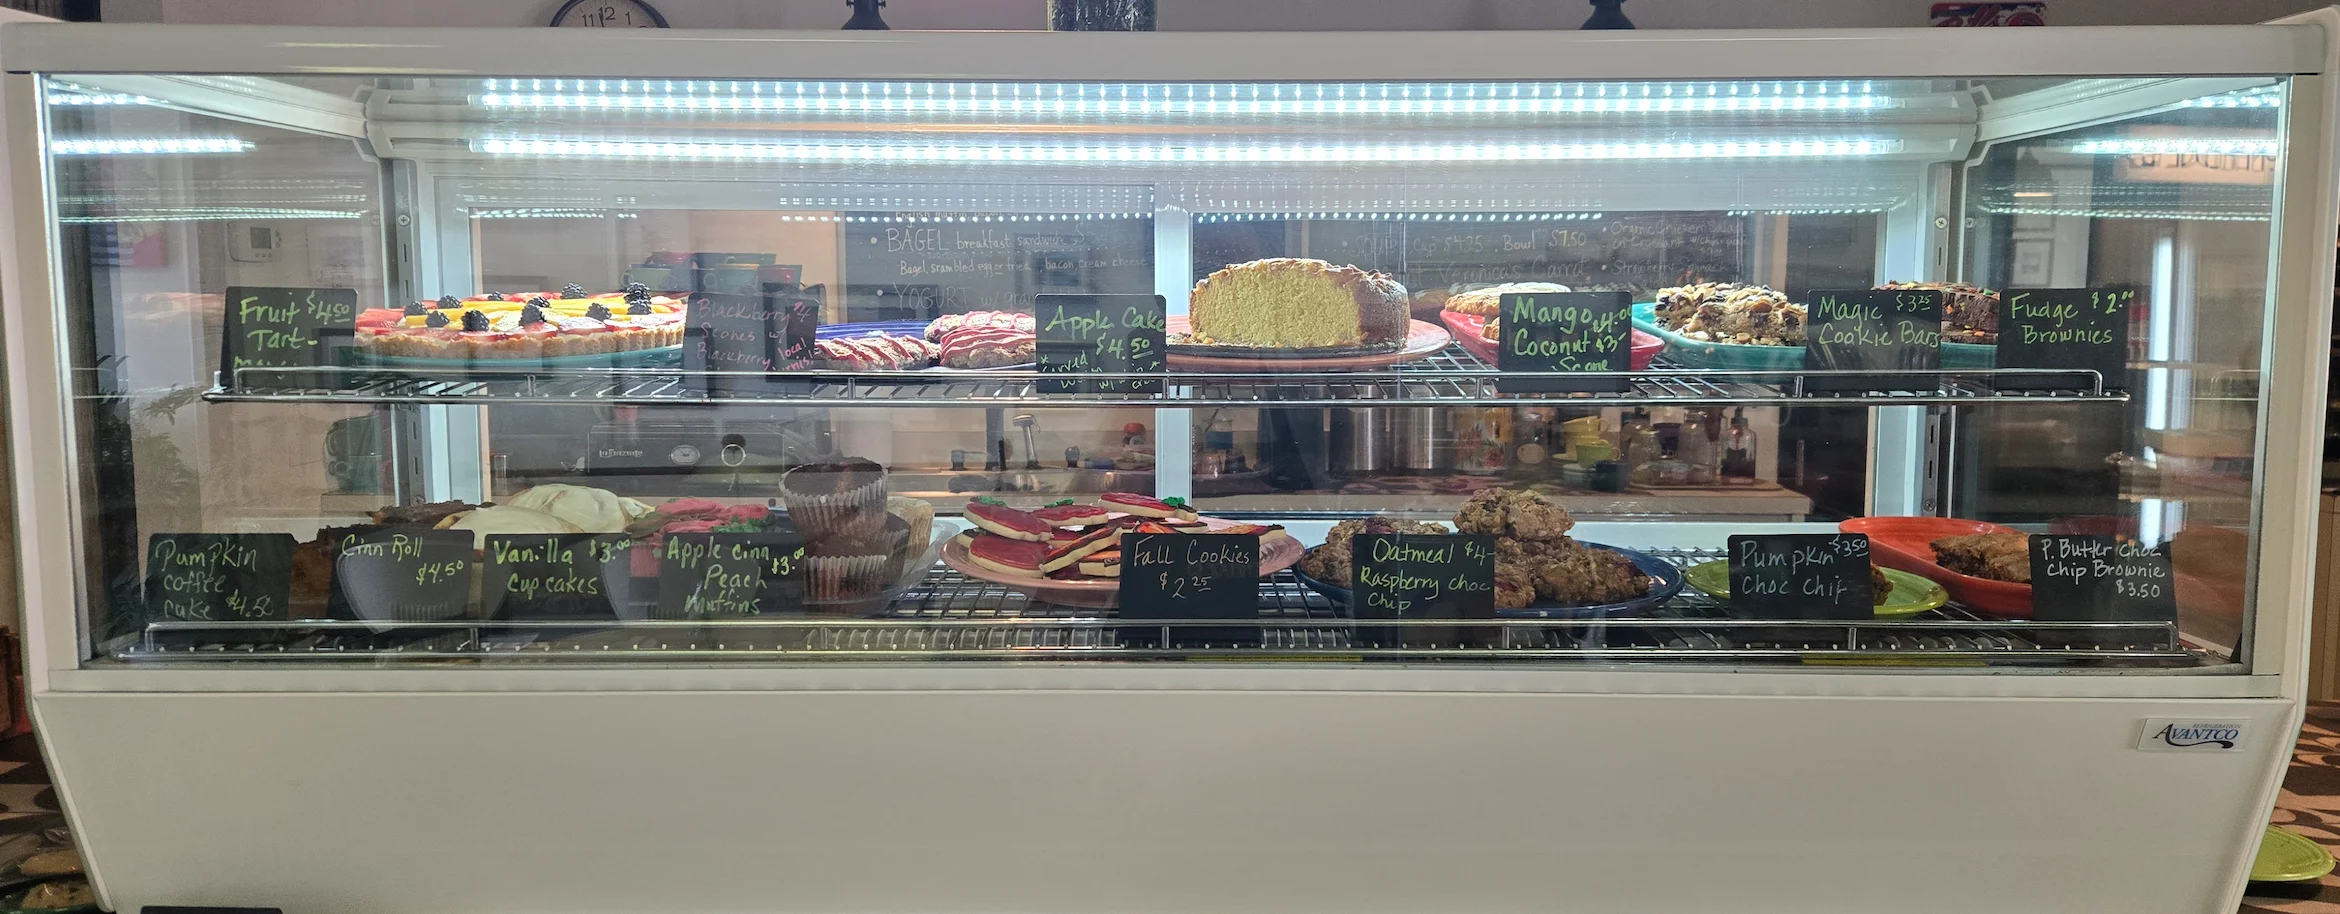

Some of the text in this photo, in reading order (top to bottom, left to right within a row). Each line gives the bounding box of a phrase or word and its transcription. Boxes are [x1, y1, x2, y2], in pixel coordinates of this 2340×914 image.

[885, 227, 950, 252] BAGEL
[956, 229, 1011, 250] breakfast
[1502, 229, 1587, 250] Bowl $7.50
[978, 263, 993, 278] egg
[1079, 259, 1108, 269] cream
[1532, 255, 1589, 279] Carrot
[892, 282, 972, 310] YOGURT
[2011, 292, 2079, 328] Fudge
[239, 297, 300, 325] Fruit
[697, 298, 790, 333] Blackberry
[1045, 304, 1166, 340] Apple Cake
[1513, 296, 1593, 335] Mango
[1818, 295, 1883, 329] Magic
[701, 322, 756, 342] Scones
[1514, 328, 1592, 356] Coconut
[1818, 320, 1942, 348] Cookie Bars
[2021, 320, 2113, 345] Brownies
[777, 337, 807, 361] local
[341, 533, 423, 563] Cinn Roll
[493, 537, 573, 565] Vanilla
[667, 535, 722, 569] Apple
[1133, 534, 1250, 568] Fall Cookies
[1373, 537, 1455, 564] Oatmeal
[2041, 538, 2055, 561] P.
[2058, 538, 2113, 560] Butter
[703, 563, 768, 590] Peach
[2092, 559, 2166, 578] Brownie
[1360, 566, 1439, 600] Raspberry
[2115, 578, 2161, 598] $3.50
[2151, 723, 2240, 749] AVANTCO
